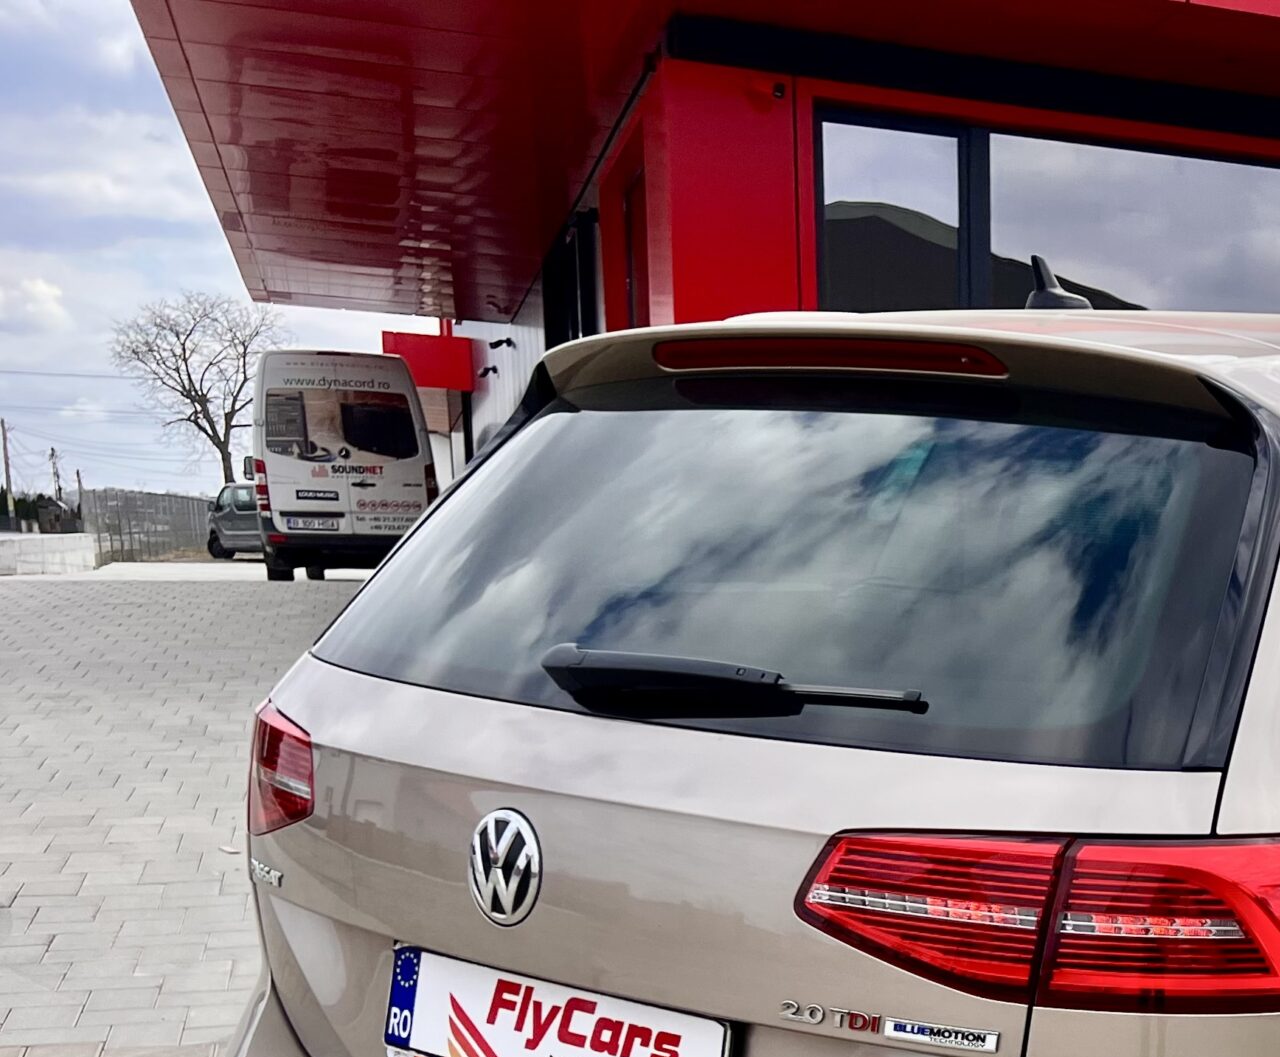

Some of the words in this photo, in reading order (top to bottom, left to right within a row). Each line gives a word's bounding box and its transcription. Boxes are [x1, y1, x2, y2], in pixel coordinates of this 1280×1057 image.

[331, 465, 384, 475] SOUNDNET
[388, 1006, 411, 1039] RO
[829, 1007, 882, 1035] TDI
[893, 1023, 987, 1044] BLUEMOTION
[929, 1036, 986, 1049] TECHNOLOGY
